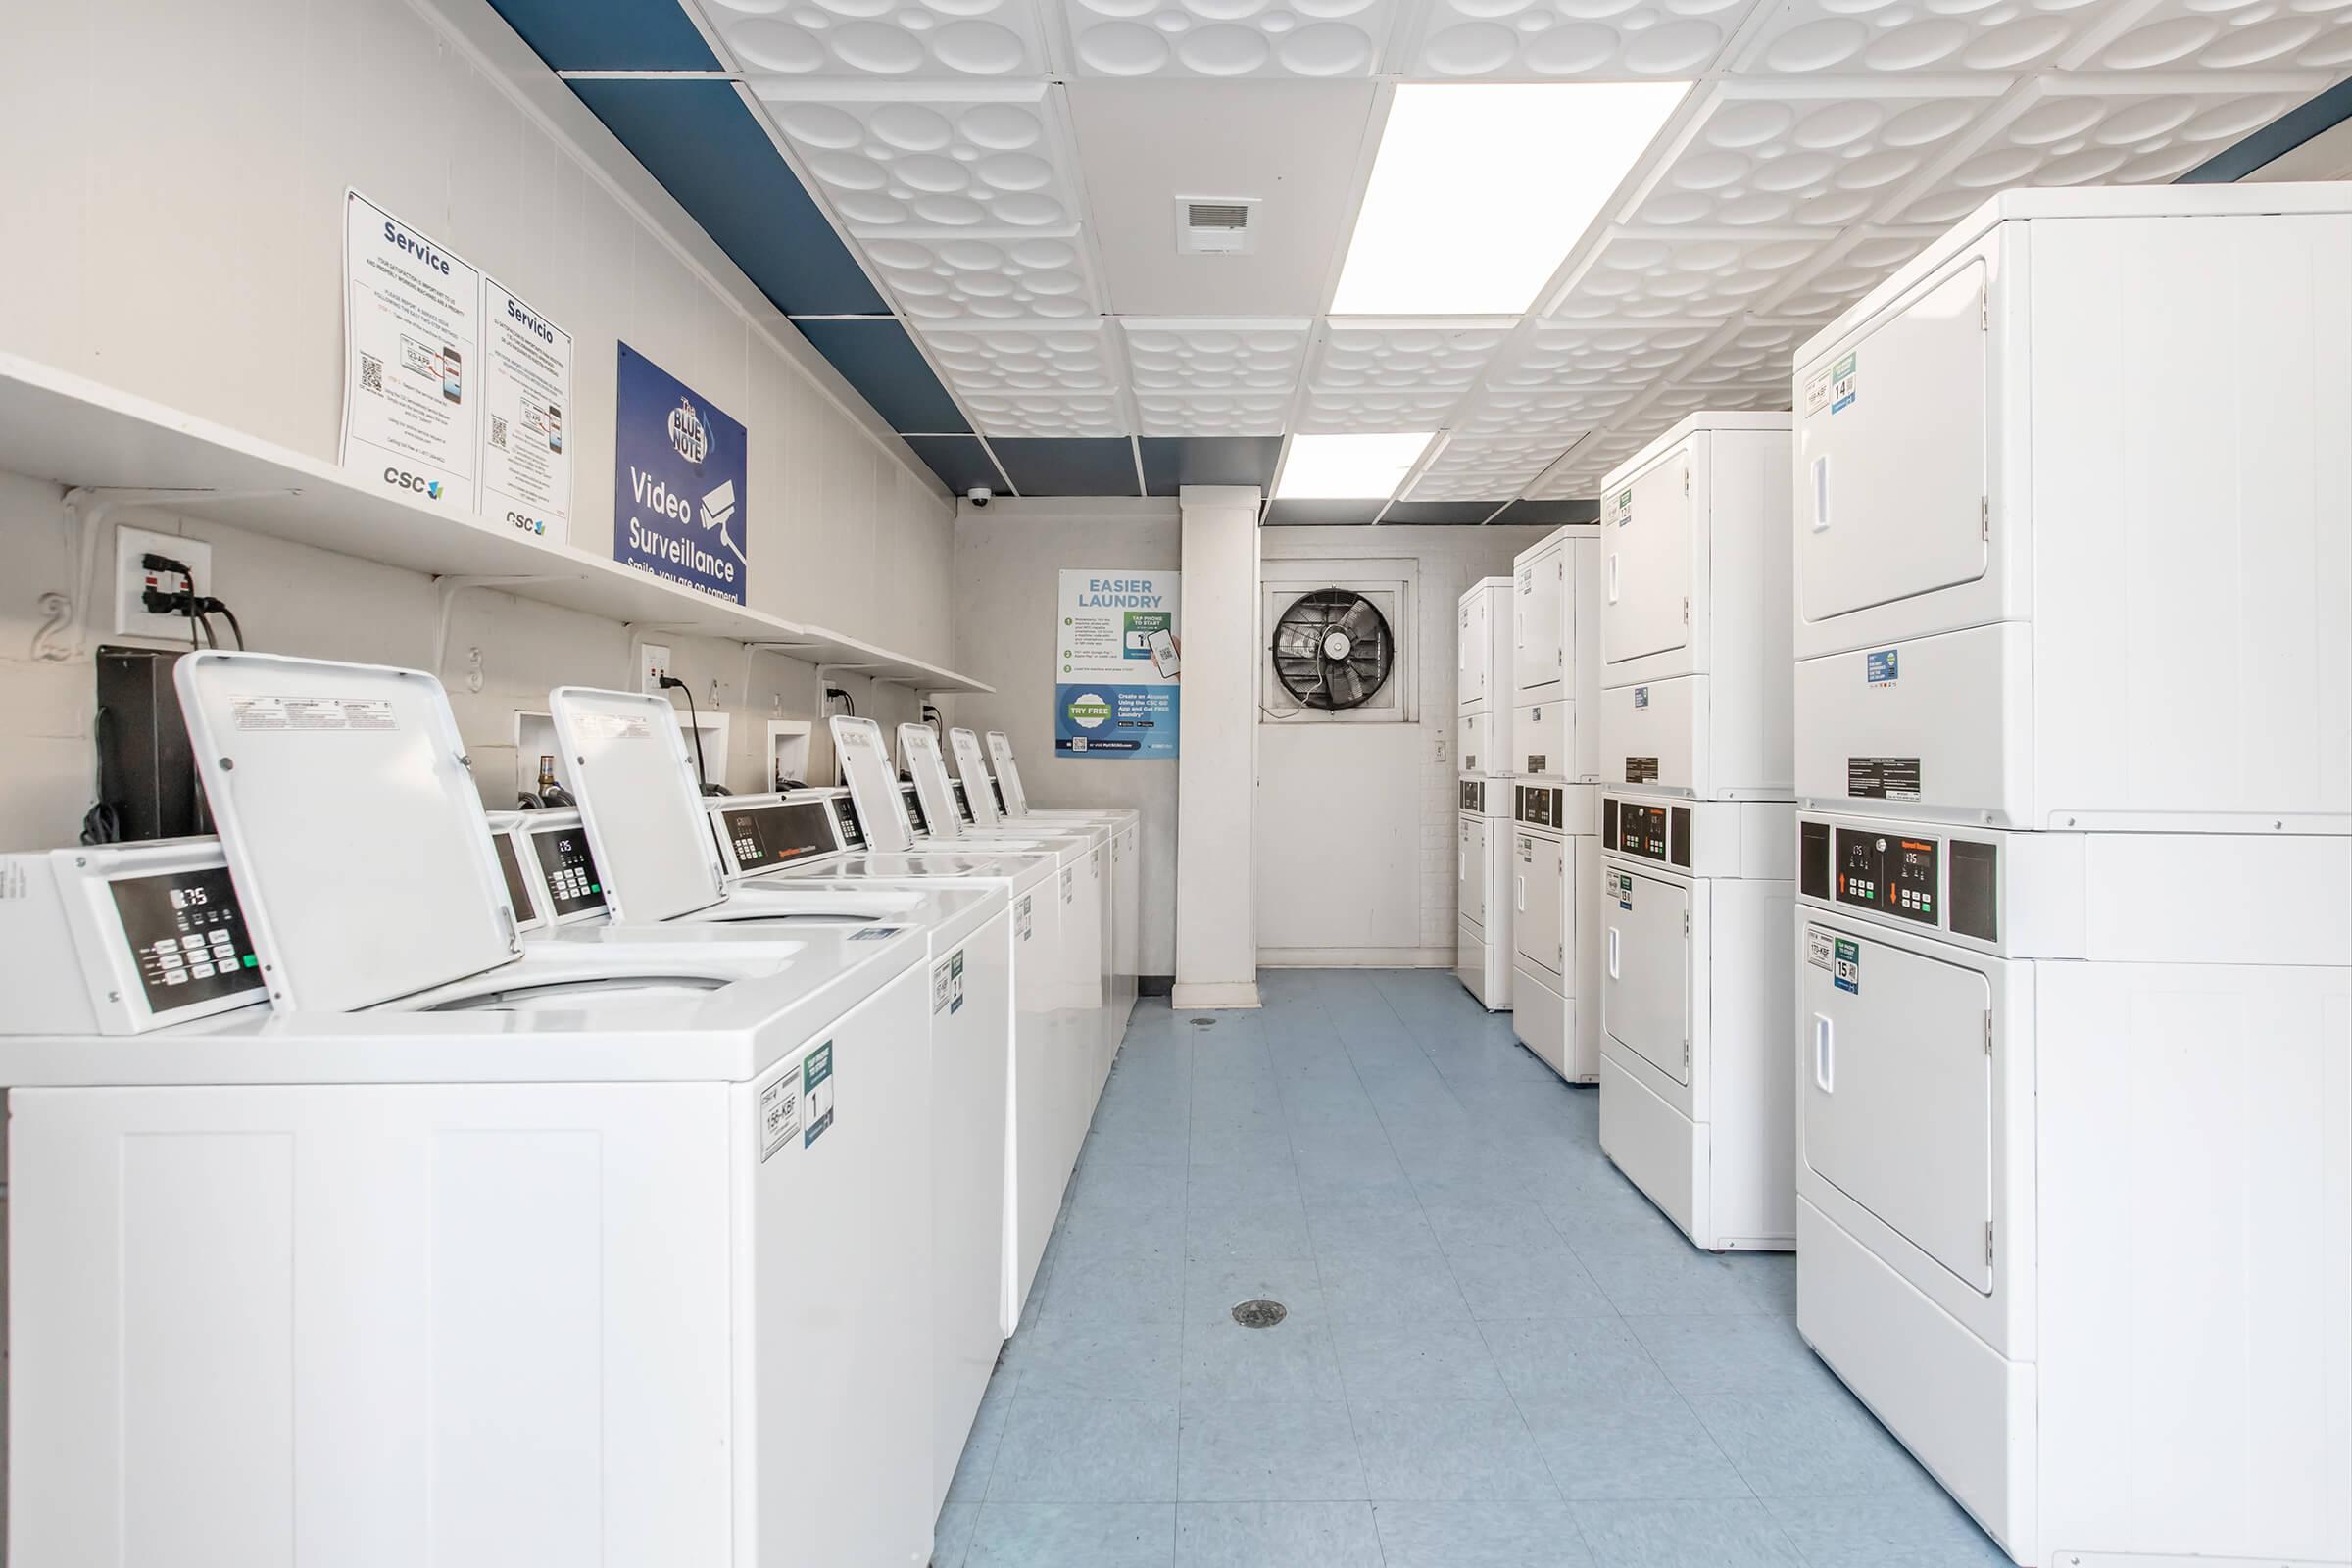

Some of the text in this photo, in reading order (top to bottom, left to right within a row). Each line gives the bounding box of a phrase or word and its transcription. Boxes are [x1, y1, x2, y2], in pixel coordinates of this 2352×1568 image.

[384, 221, 450, 275] Service
[507, 298, 554, 345] Servicio
[1835, 381, 1846, 399] 14
[681, 395, 696, 417] The
[674, 412, 702, 443] BLUE
[673, 430, 702, 463] NOTE
[383, 466, 425, 494] CSC
[630, 466, 691, 525] Video
[629, 517, 734, 583] Surveillance
[1089, 579, 1153, 593] EASIER
[1078, 594, 1162, 608] LAUNDRY
[1838, 961, 1847, 977] 15
[767, 1096, 796, 1130] 156-KBF
[812, 1093, 817, 1118] 1
